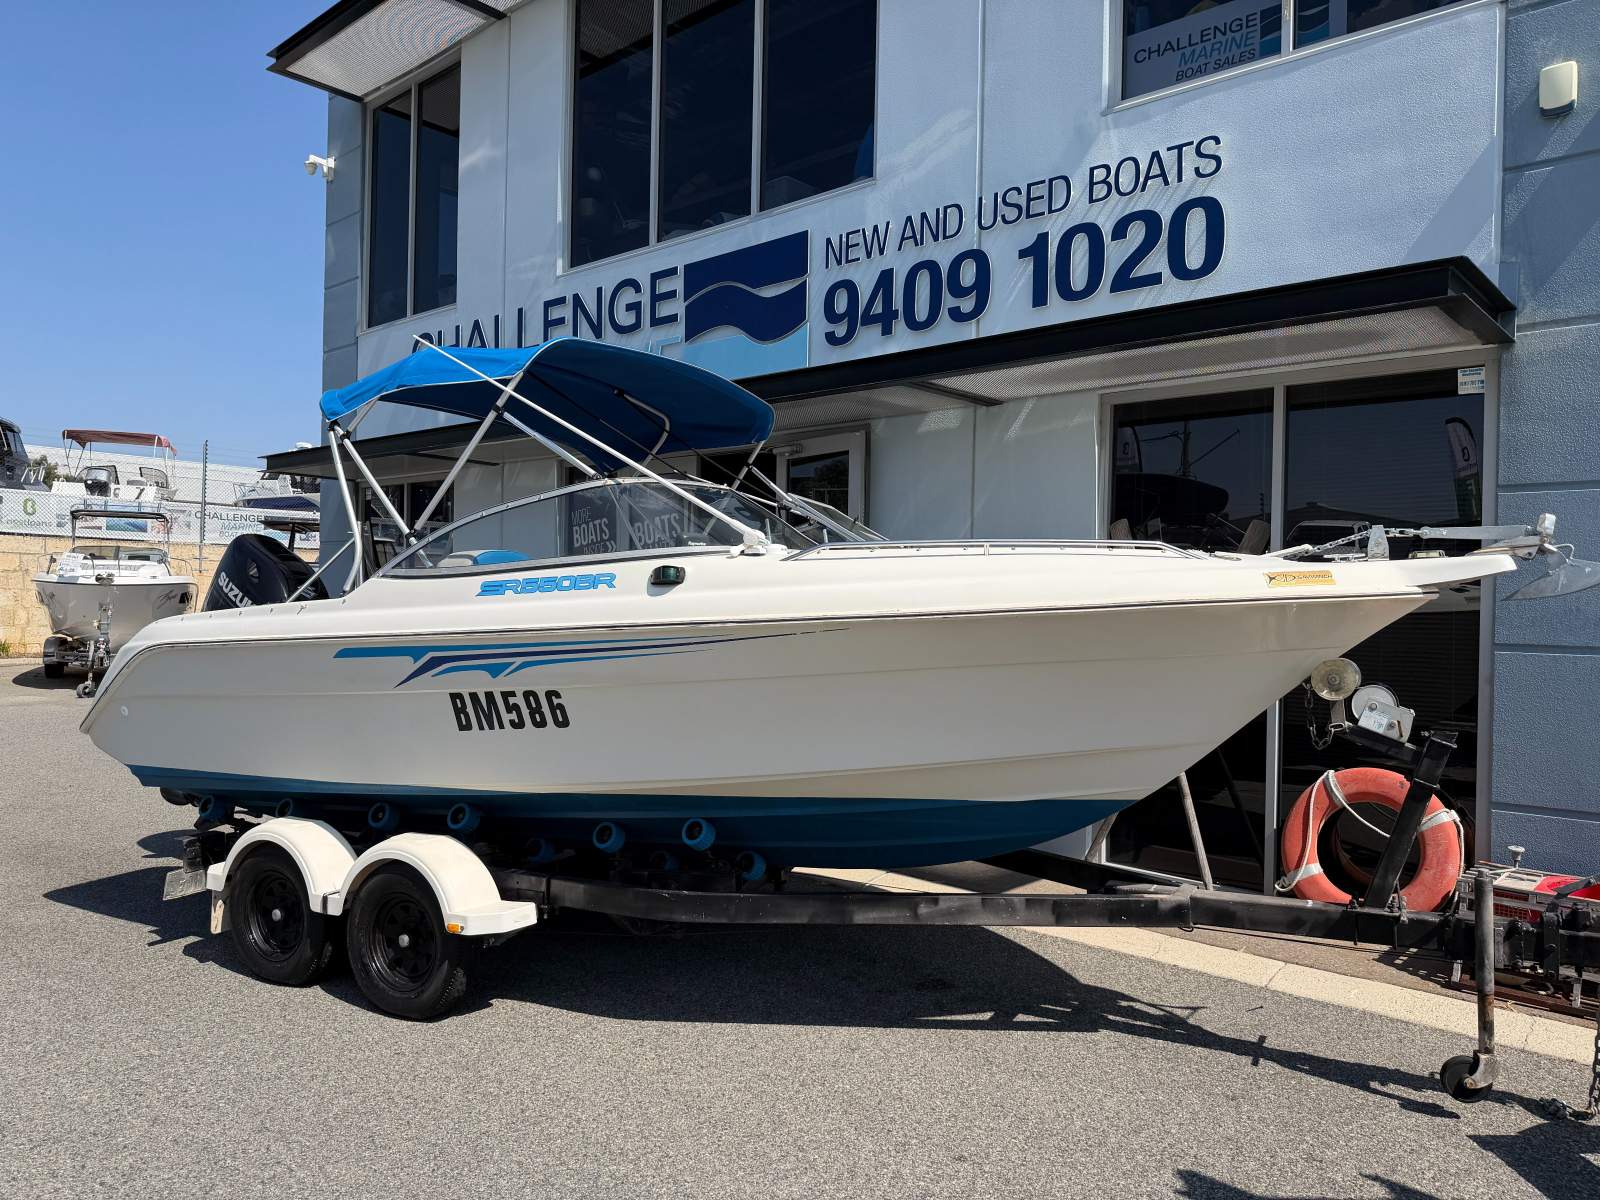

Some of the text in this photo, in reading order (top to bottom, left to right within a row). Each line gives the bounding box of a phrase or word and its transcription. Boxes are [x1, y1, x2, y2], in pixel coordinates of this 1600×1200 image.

[1133, 12, 1258, 64] CHALLENGE
[1178, 29, 1258, 67] MARINE
[1175, 48, 1257, 82] BOAT SALES
[825, 135, 1223, 269] NEW AND USED BOATS
[823, 195, 1227, 347] 9409 1020
[194, 510, 263, 523] CHALLENGE
[572, 517, 610, 548] BOATS
[634, 512, 681, 547] BOATS
[449, 689, 571, 732] BM586
